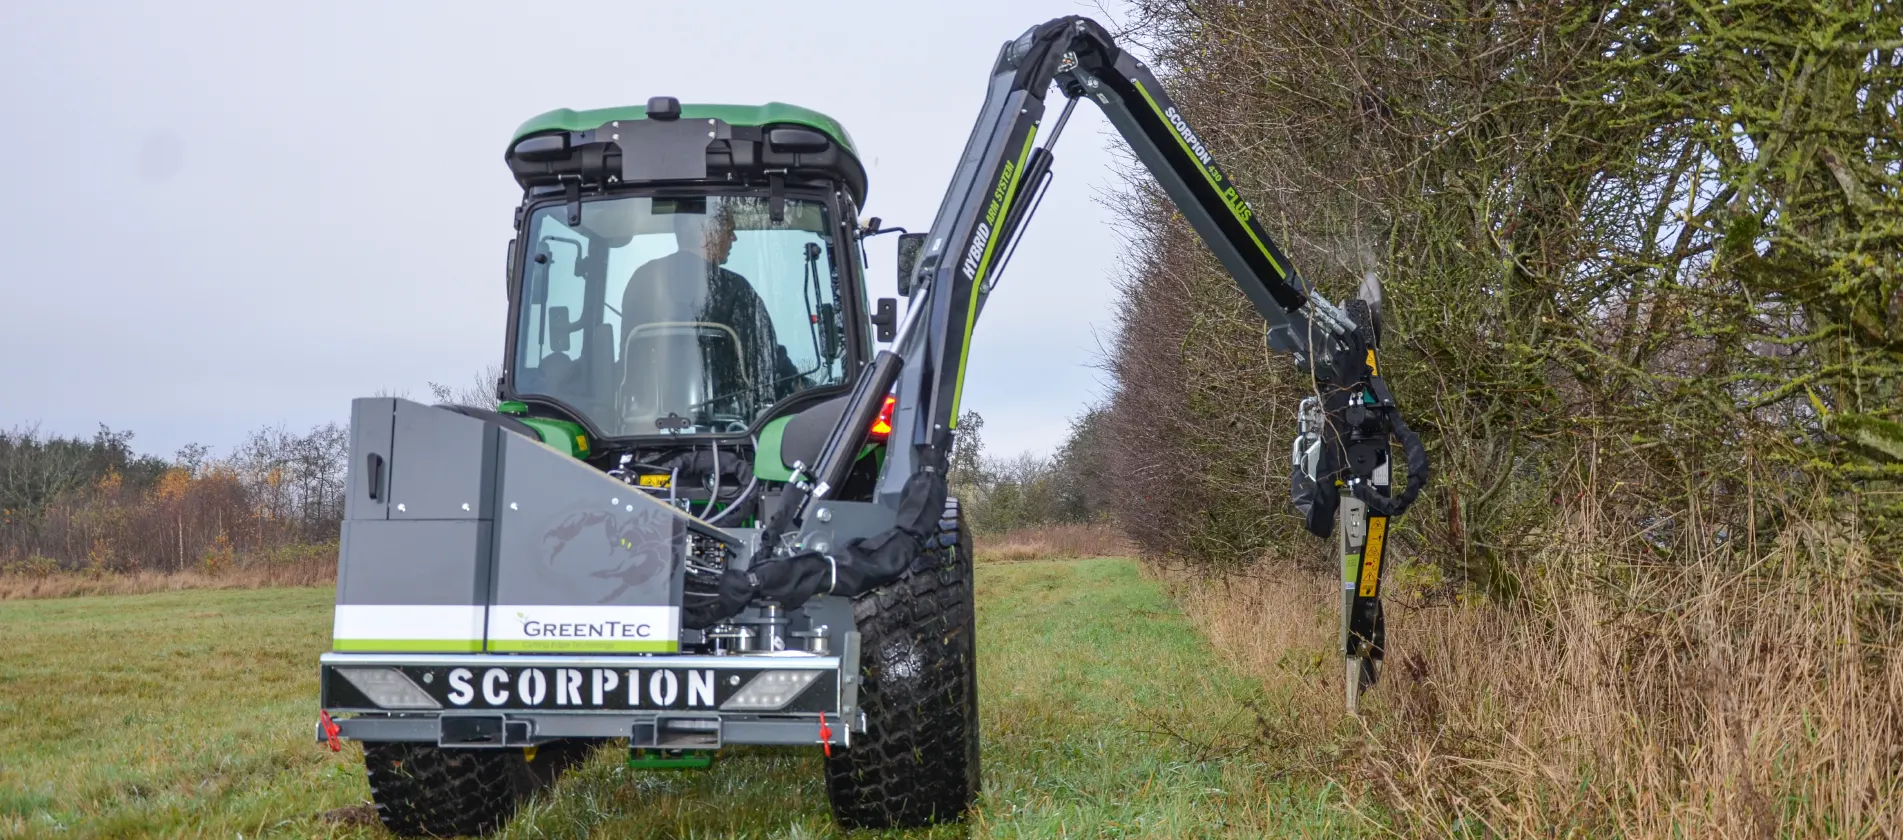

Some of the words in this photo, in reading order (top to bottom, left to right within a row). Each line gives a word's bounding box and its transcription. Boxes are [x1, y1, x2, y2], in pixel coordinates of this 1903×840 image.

[962, 222, 990, 280] HYBRID
[985, 199, 1000, 226] ARM
[994, 159, 1015, 202] SYSTEM
[1165, 106, 1212, 165] SCORPION
[1208, 165, 1222, 182] 430
[1224, 186, 1252, 221] PLUS
[447, 668, 715, 706] SCORPION
